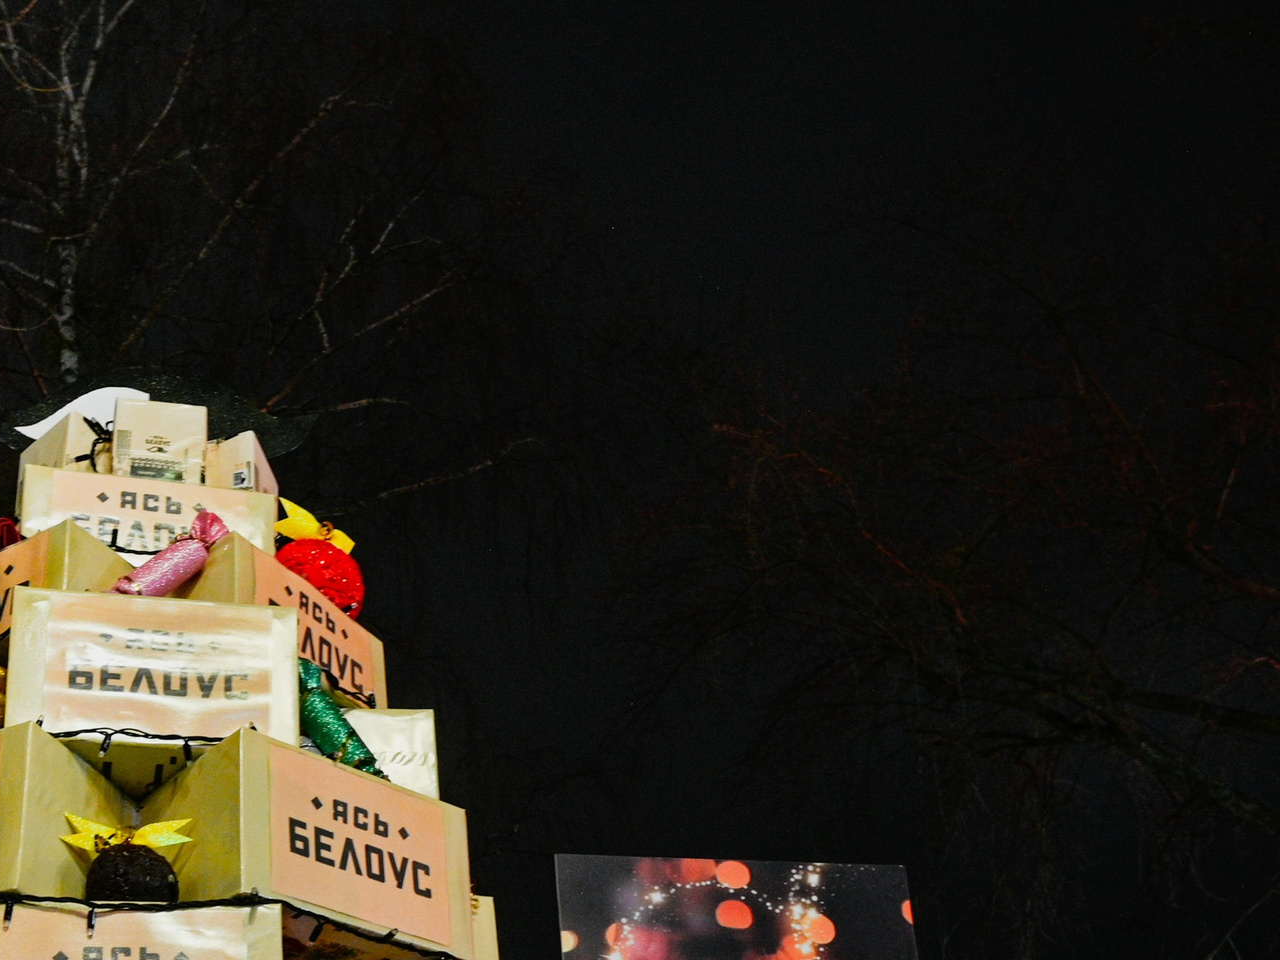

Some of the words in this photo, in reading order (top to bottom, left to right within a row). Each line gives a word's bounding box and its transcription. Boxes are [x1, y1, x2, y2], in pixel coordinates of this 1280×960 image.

[120, 491, 182, 515] ЯСЬ
[299, 590, 336, 635] ЯСЬ
[332, 799, 389, 838] ЯСЬ
[289, 816, 432, 899] БЕЛОУС
